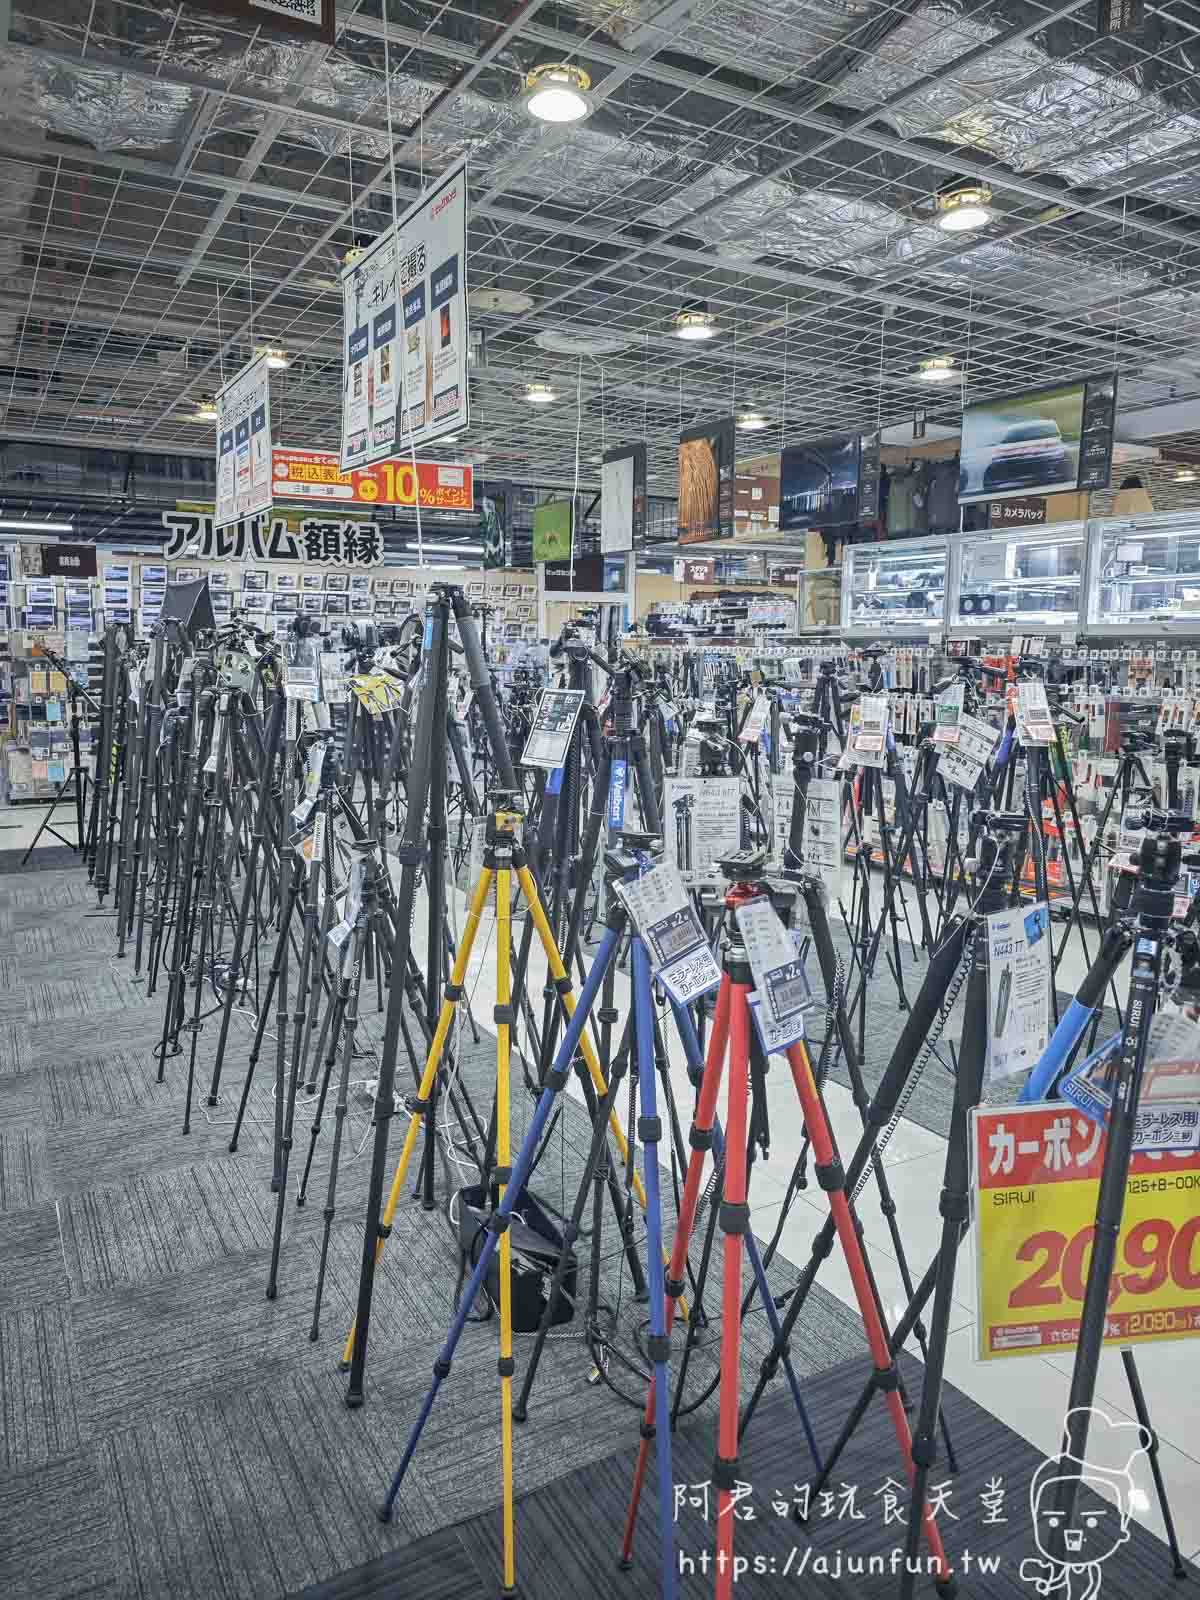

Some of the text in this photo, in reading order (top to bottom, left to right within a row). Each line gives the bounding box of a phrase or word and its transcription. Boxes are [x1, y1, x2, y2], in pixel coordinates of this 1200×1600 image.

[1004, 507, 1044, 519] カメラバッグ
[1130, 999, 1143, 1028] SIRUI
[1063, 1082, 1094, 1108] SIRUI
[989, 1117, 1101, 1176] カーボン
[993, 1190, 1035, 1206] SIRUI
